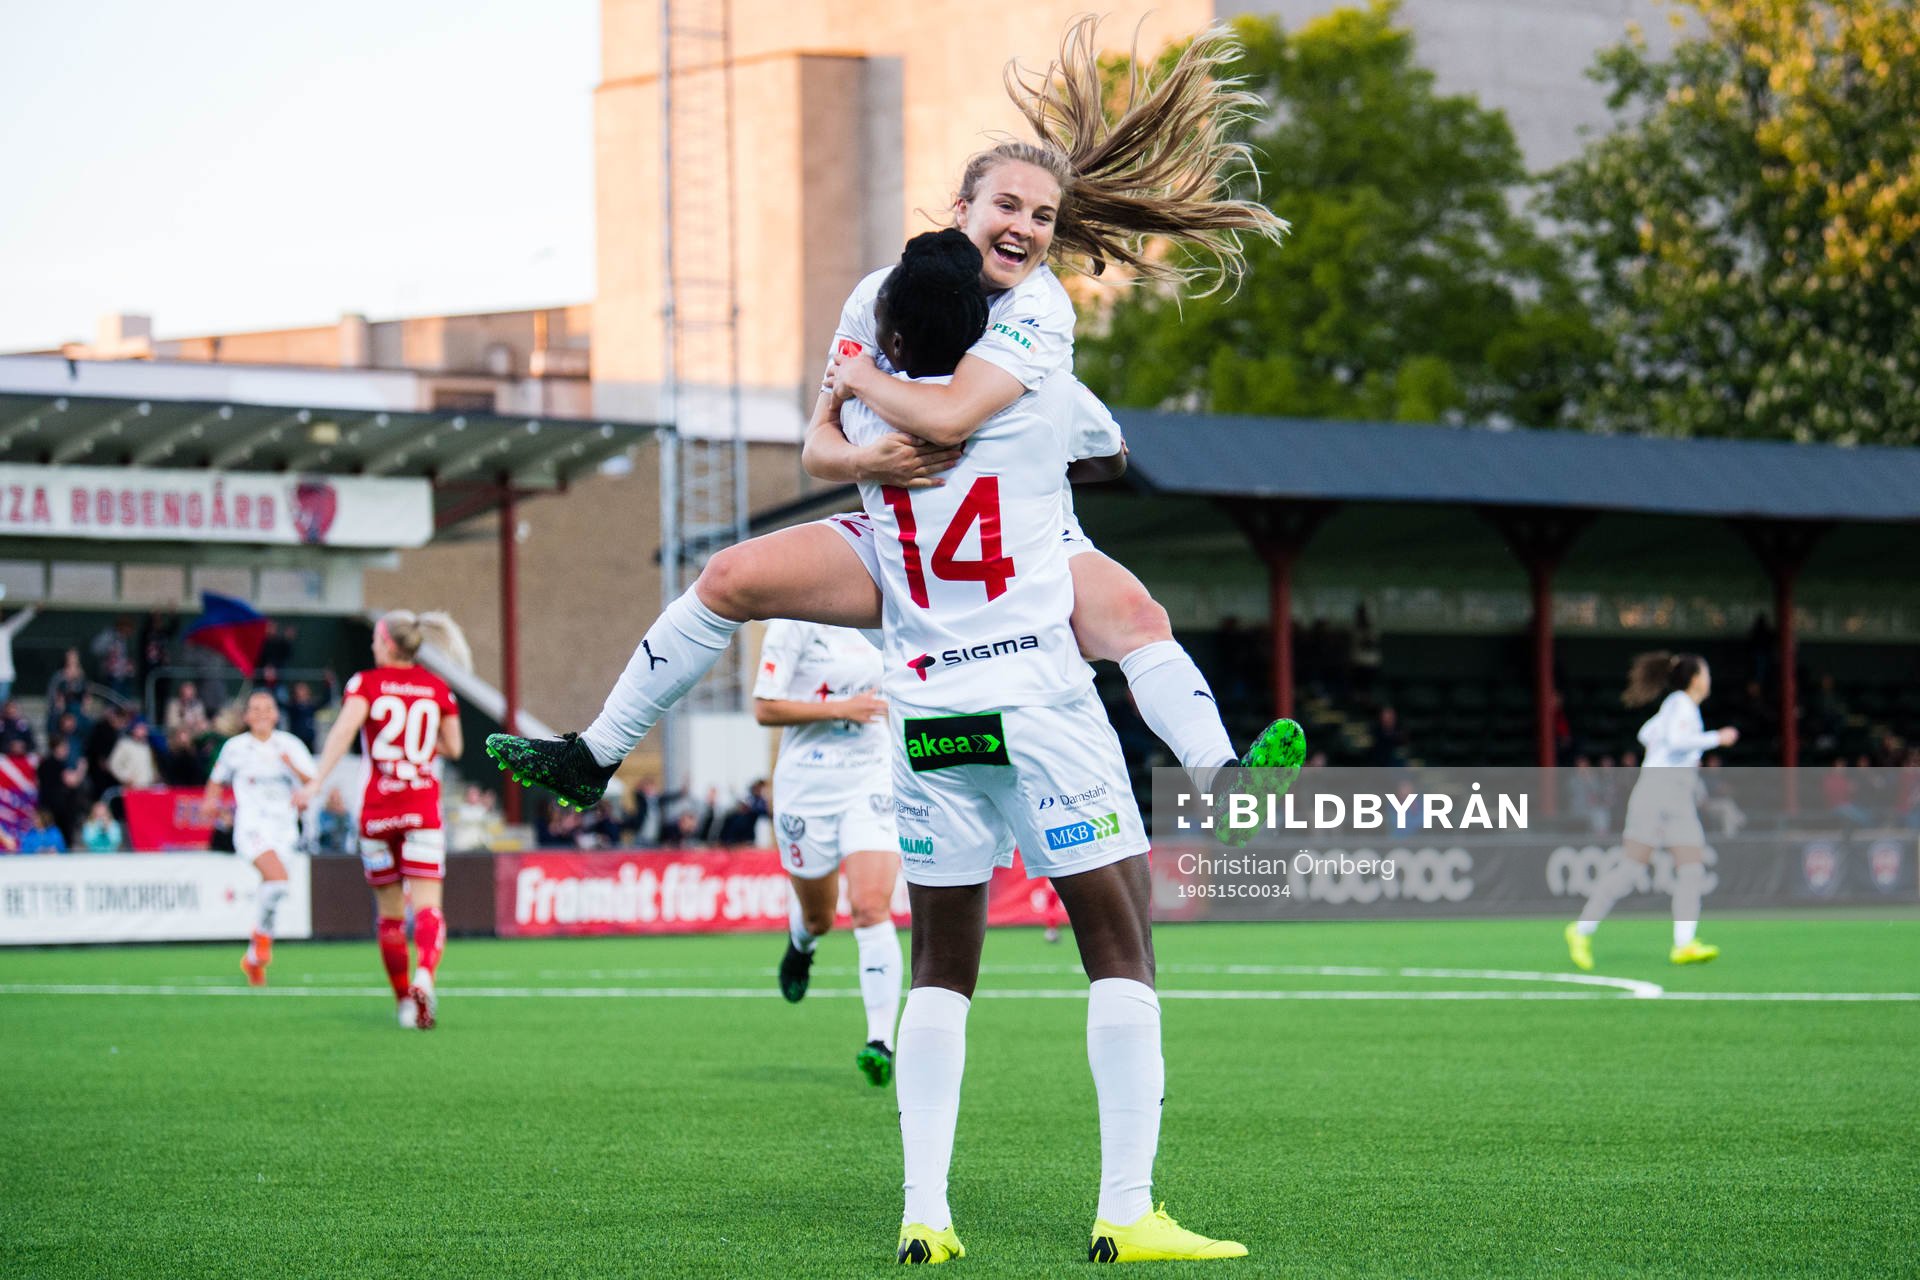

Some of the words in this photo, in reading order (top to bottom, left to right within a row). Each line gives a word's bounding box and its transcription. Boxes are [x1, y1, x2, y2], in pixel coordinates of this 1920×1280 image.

[0, 485, 51, 523] ZA
[70, 477, 276, 530] ROSENGÅRD
[882, 476, 1016, 609] 14
[370, 694, 440, 765] 20
[908, 733, 973, 758] akea
[1050, 825, 1089, 847] MKB
[661, 863, 723, 920] för
